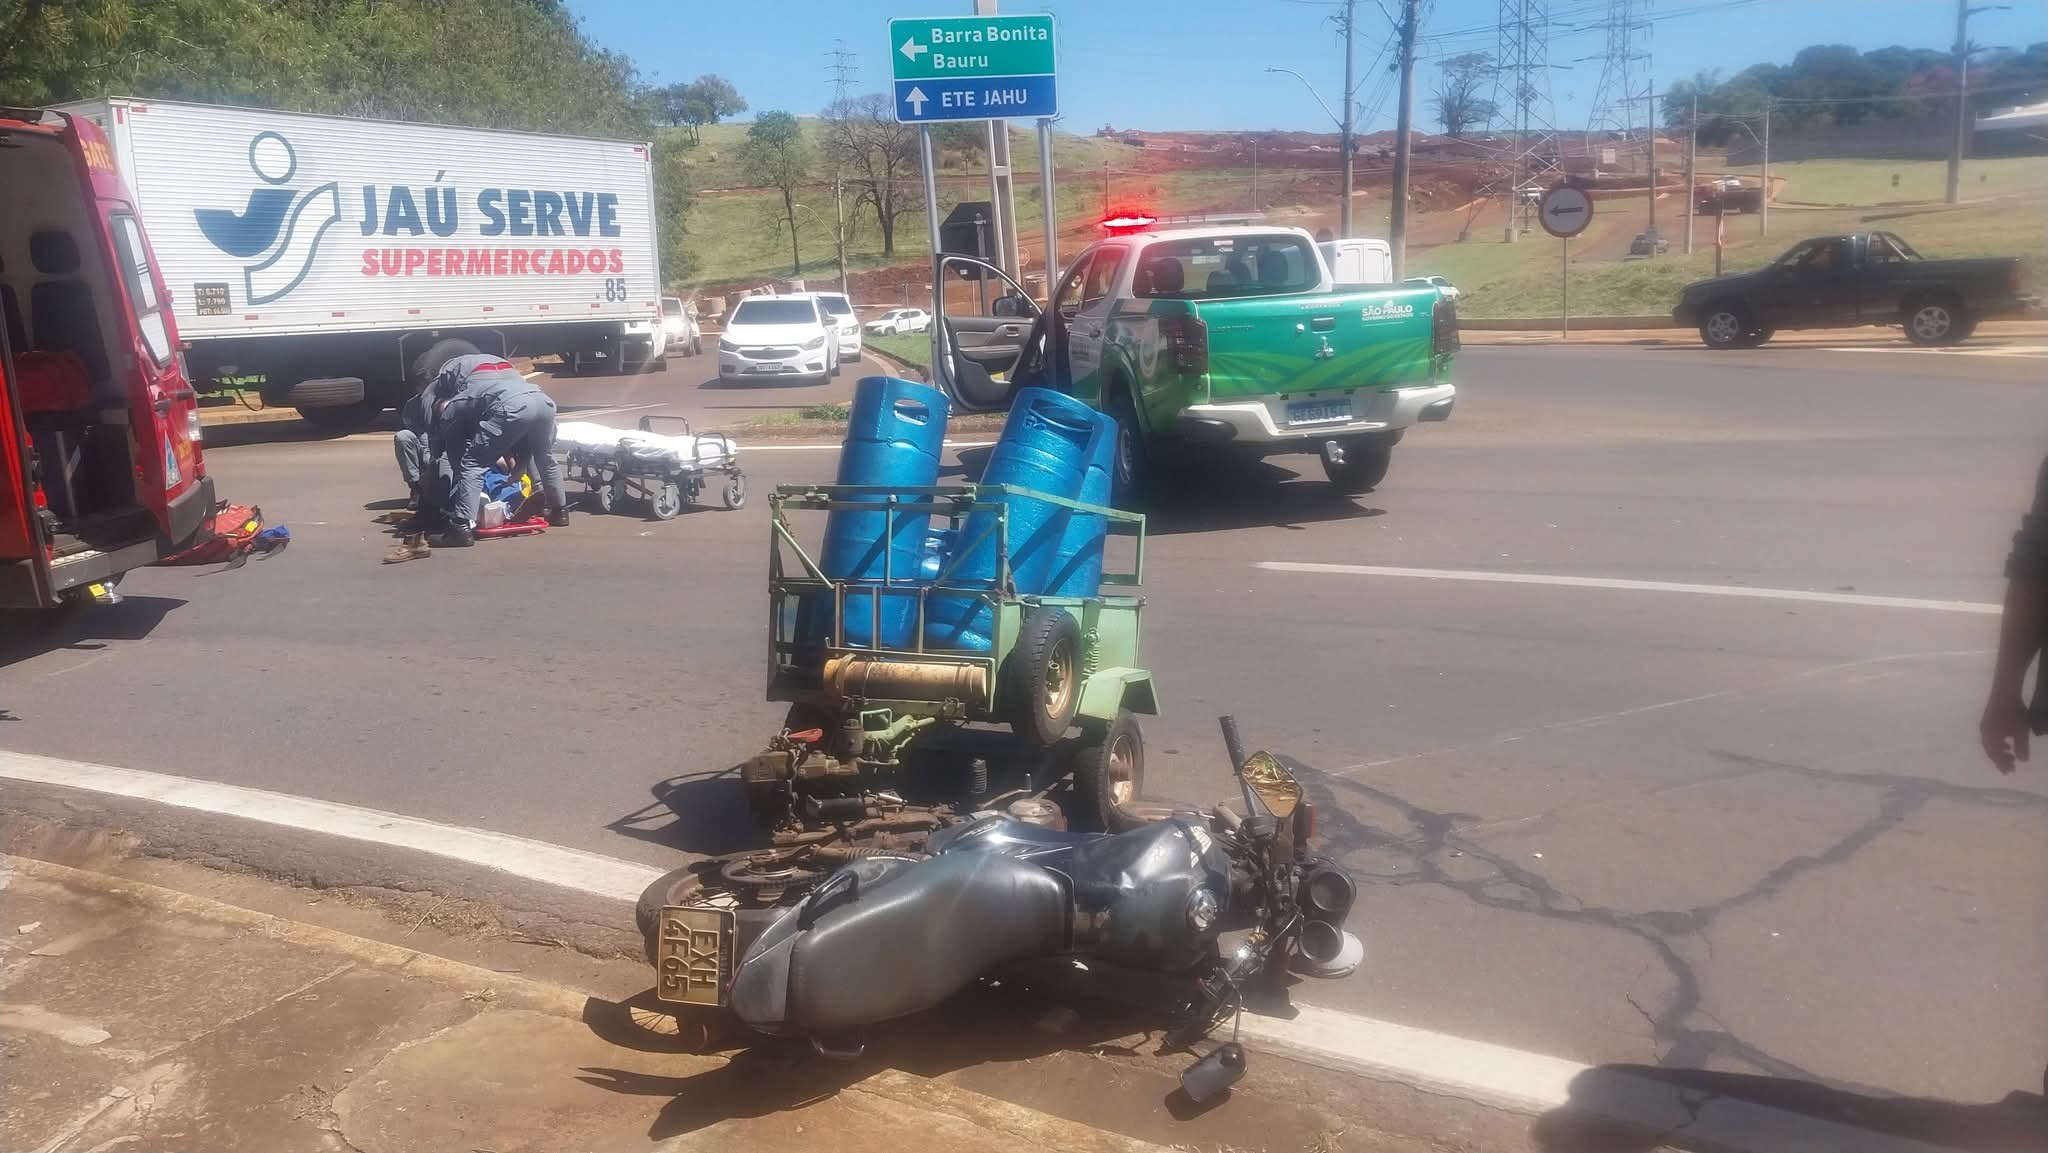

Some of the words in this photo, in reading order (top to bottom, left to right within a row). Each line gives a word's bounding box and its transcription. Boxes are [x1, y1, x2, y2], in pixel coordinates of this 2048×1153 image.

[931, 28, 983, 44] Barra
[987, 25, 1048, 42] Bonita
[933, 53, 988, 69] Bauru
[941, 91, 976, 107] ETE
[983, 88, 1027, 106] JAHU
[360, 170, 459, 237] JAÚ
[476, 188, 621, 237] SERVE
[360, 248, 624, 276] SUPERMERCADOS
[605, 278, 627, 302] 85
[1361, 305, 1381, 316] SÃO
[1383, 304, 1413, 315] PAULO
[663, 918, 691, 995] 4F65
[690, 929, 719, 988] EXH
